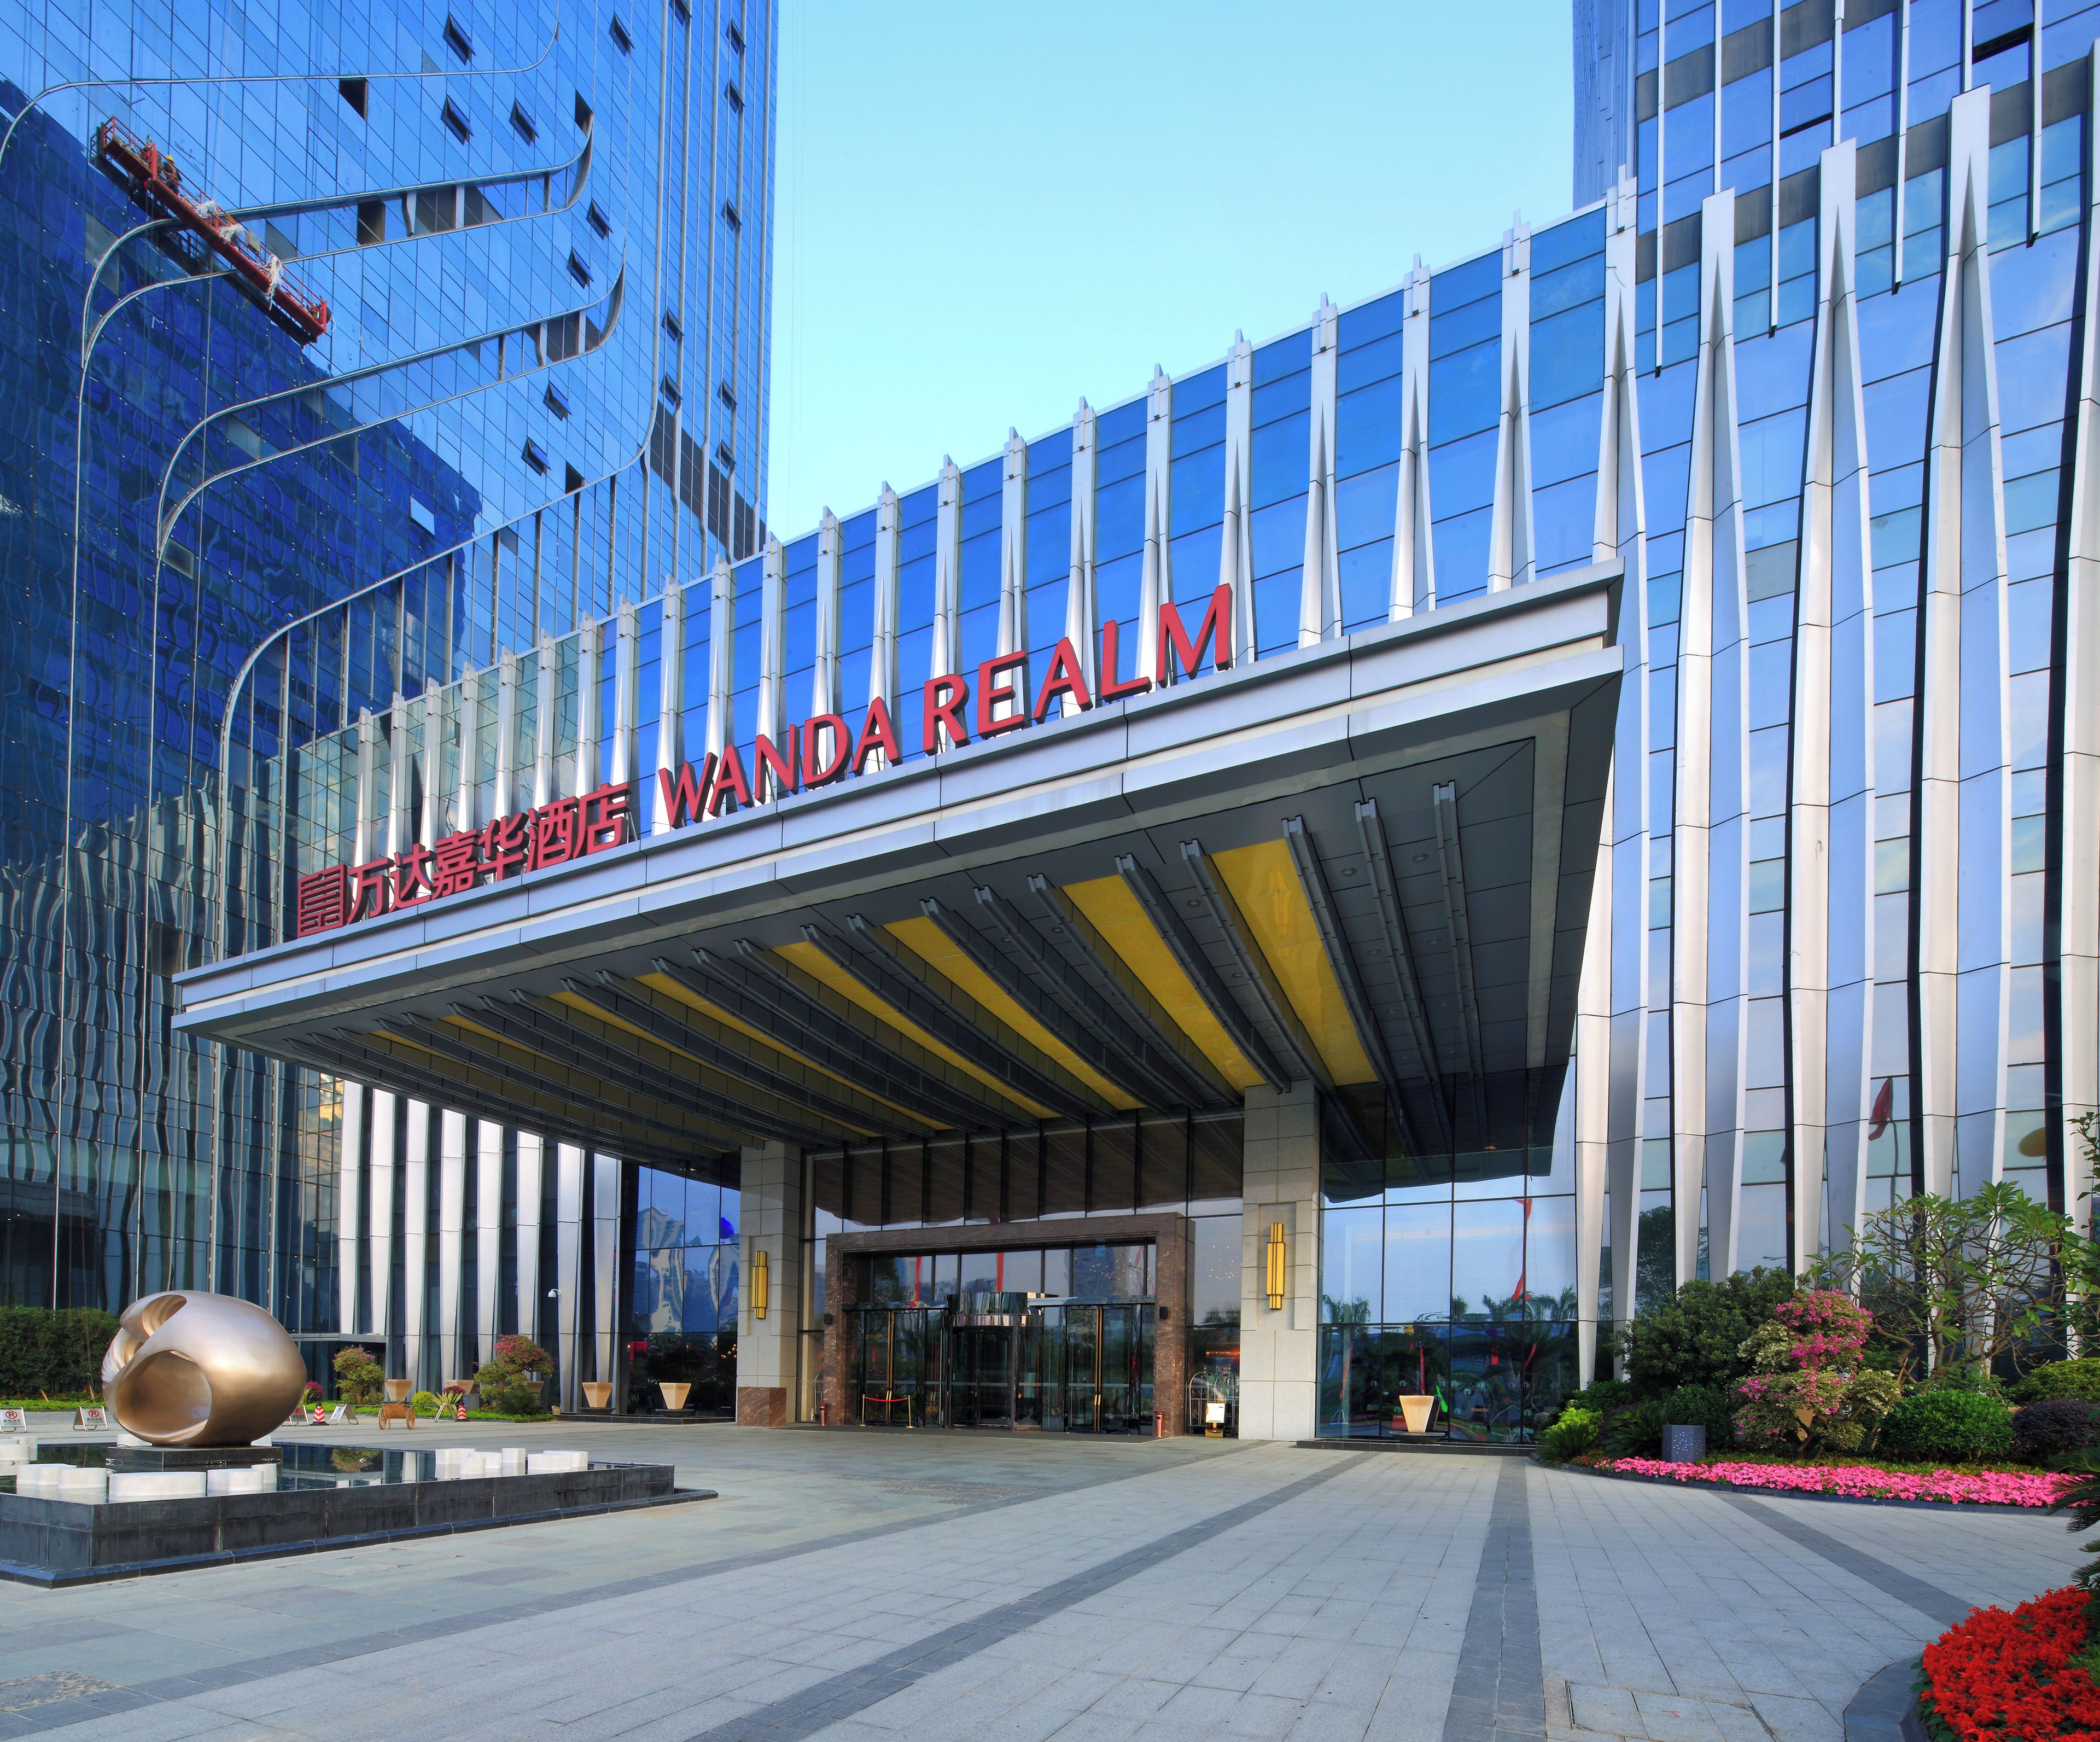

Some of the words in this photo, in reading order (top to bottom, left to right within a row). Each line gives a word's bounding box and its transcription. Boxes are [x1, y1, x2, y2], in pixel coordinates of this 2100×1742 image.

[658, 696, 903, 829] WANDA
[922, 583, 1232, 755] REALM
[347, 782, 633, 924] 万达嘉华酒店
